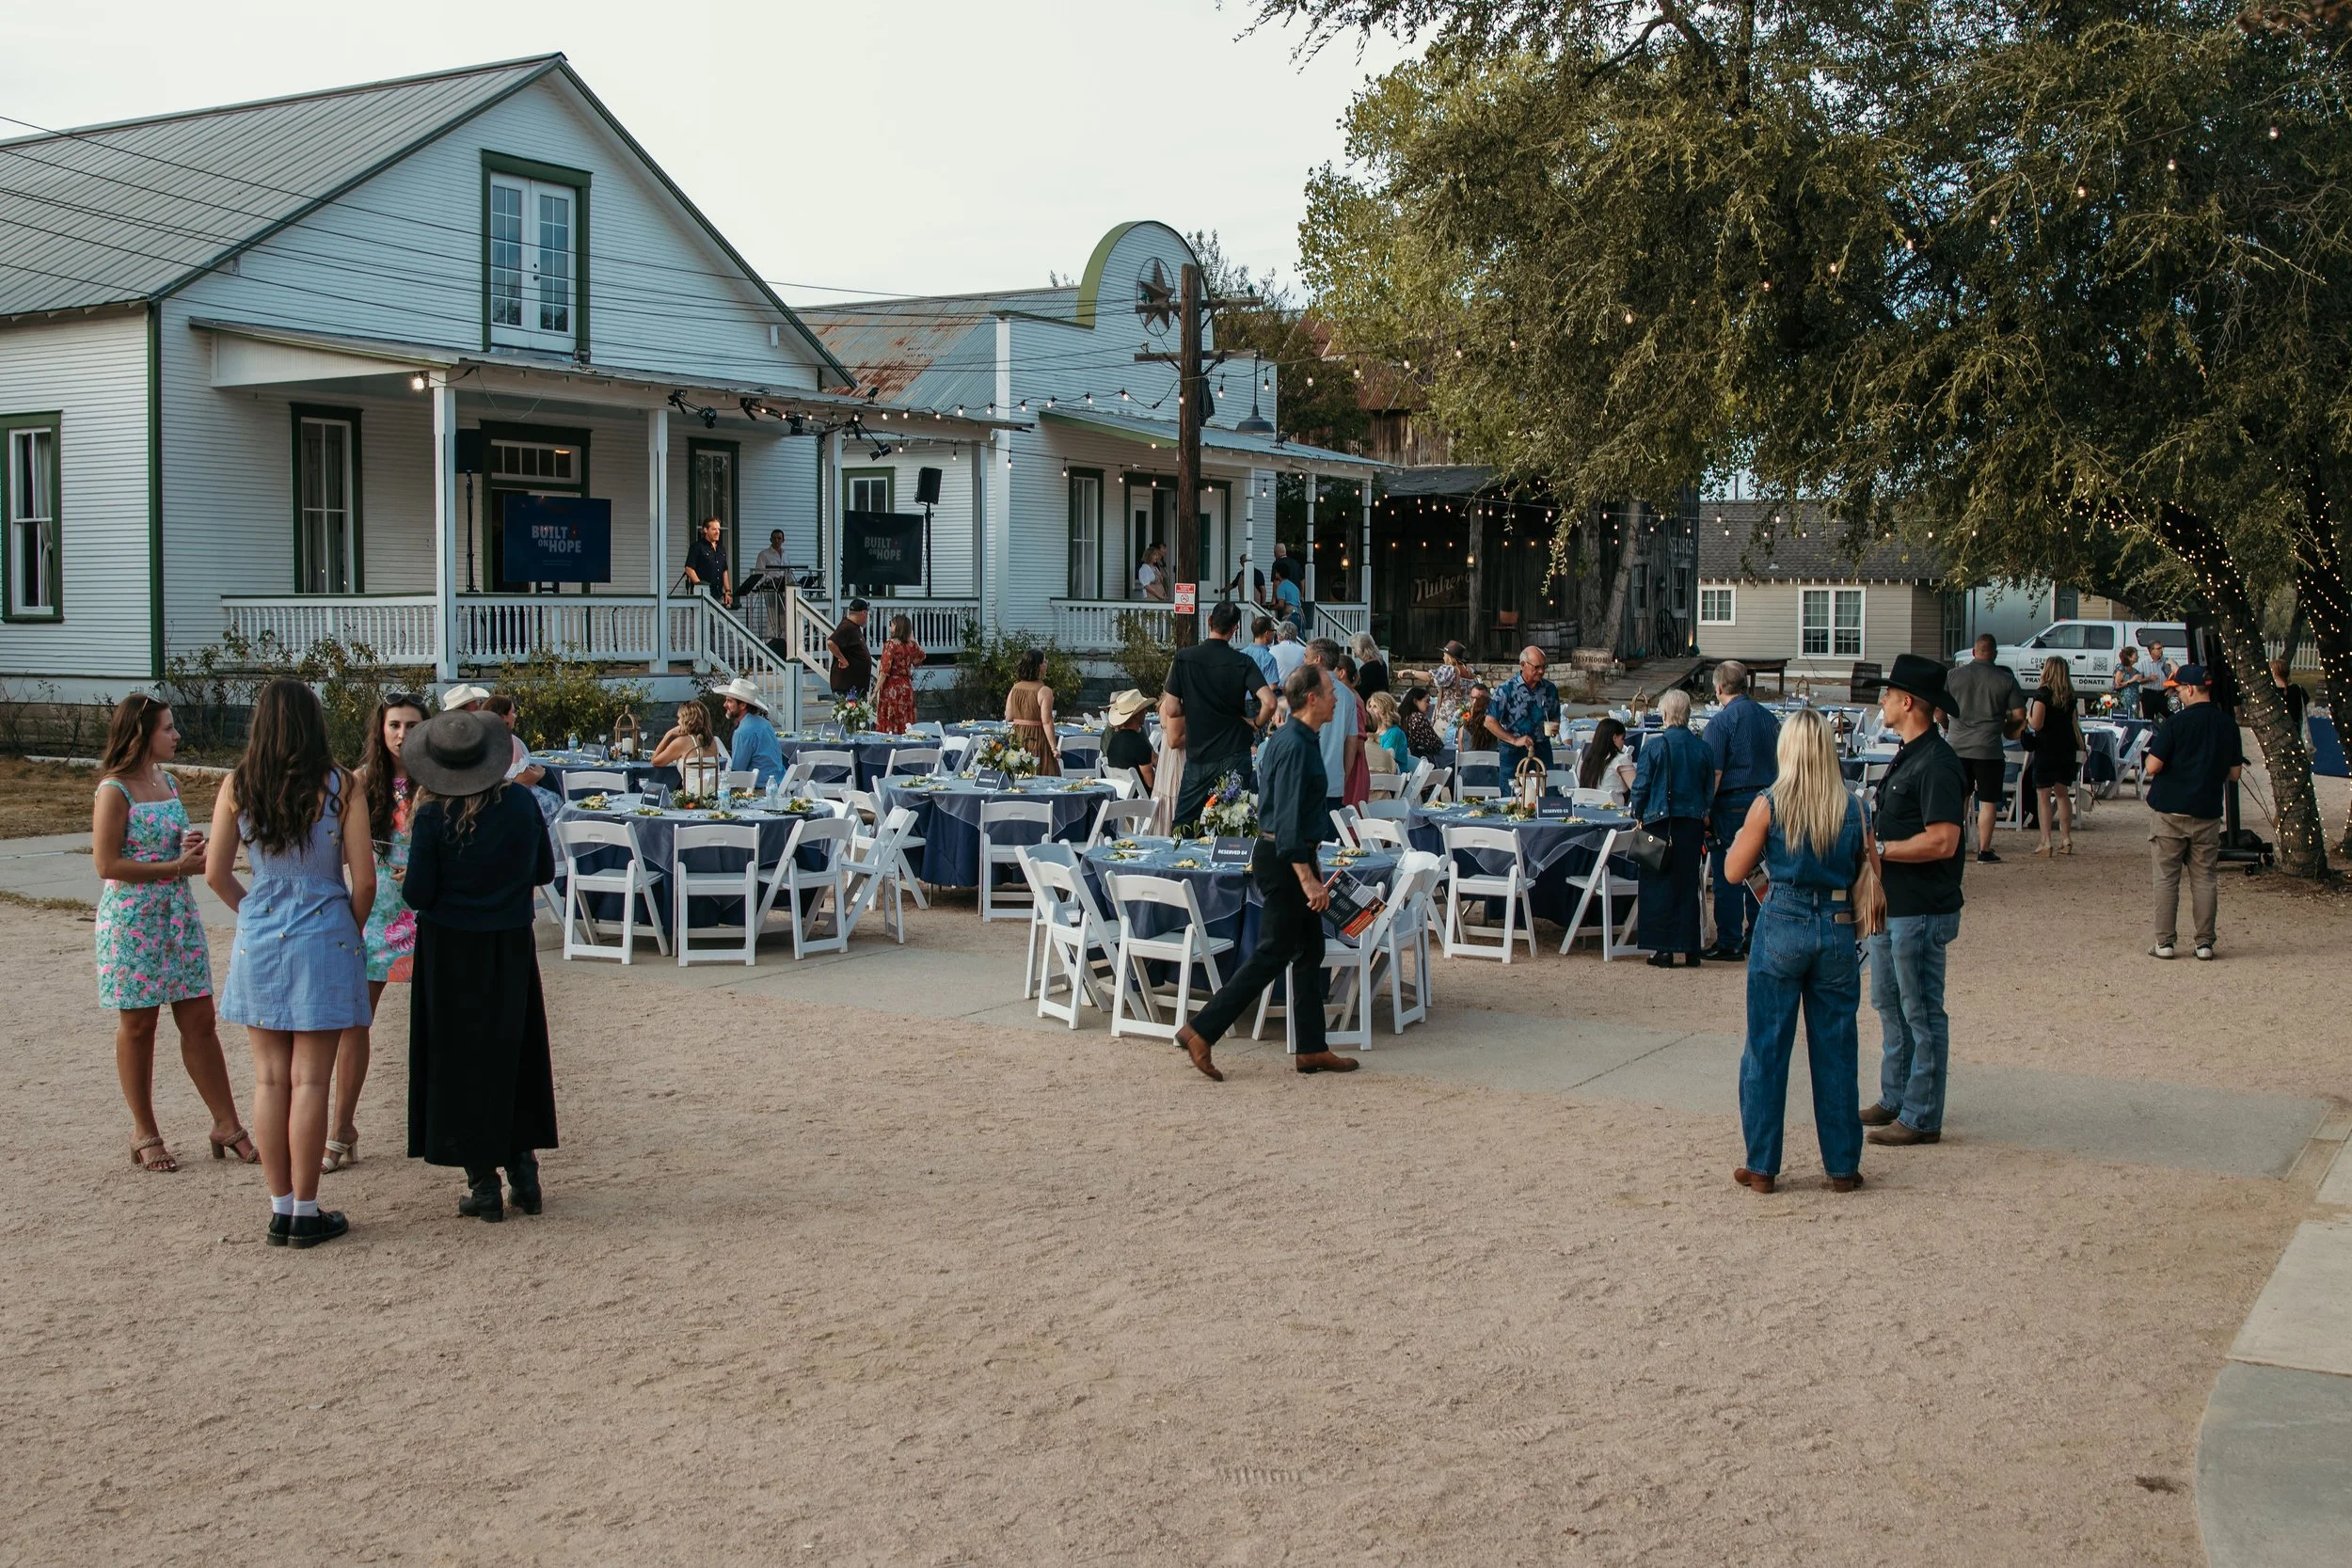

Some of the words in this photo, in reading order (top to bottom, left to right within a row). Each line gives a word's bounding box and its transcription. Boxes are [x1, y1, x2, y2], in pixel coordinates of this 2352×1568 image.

[532, 526, 568, 539] BUILT
[538, 539, 549, 547] ON
[548, 539, 582, 553] HOPE
[864, 536, 892, 548] BUILT
[877, 548, 901, 562] HOPE
